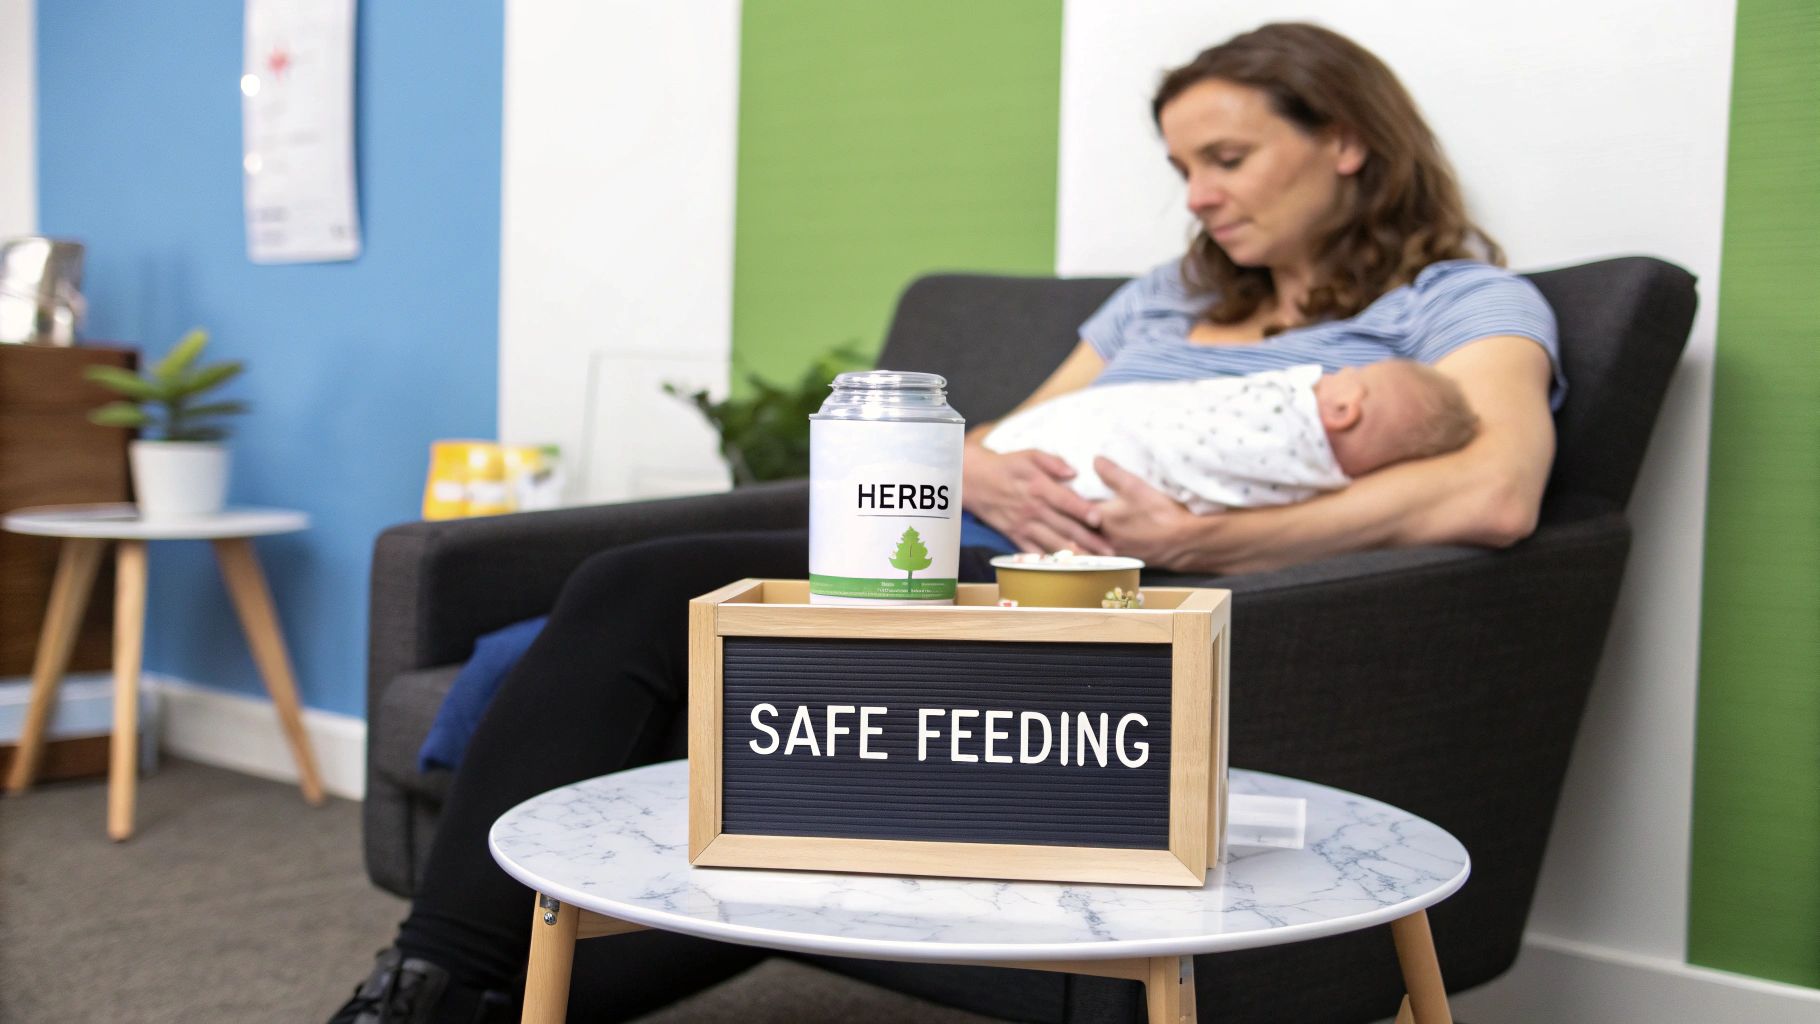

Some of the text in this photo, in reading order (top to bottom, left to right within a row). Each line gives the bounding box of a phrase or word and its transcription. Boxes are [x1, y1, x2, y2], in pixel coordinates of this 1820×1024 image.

[858, 484, 949, 511] HERBS
[748, 703, 1150, 768] SAFE FEEDING
